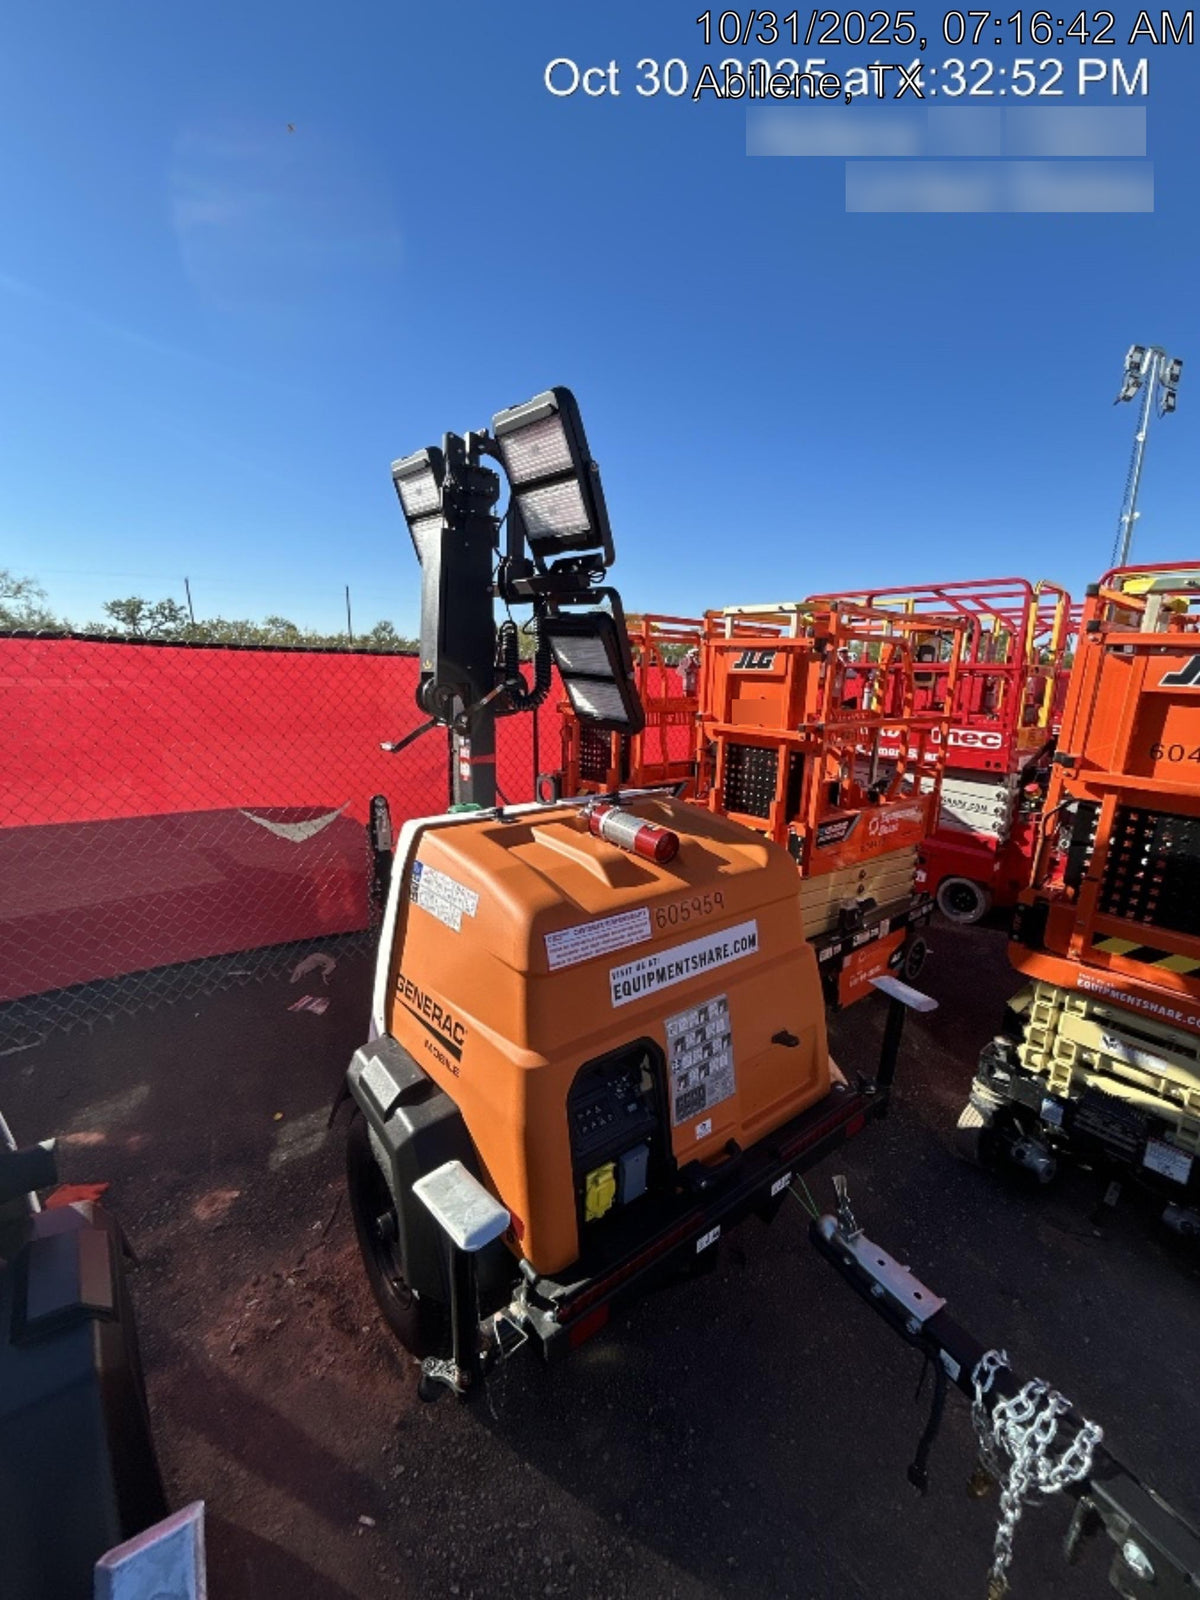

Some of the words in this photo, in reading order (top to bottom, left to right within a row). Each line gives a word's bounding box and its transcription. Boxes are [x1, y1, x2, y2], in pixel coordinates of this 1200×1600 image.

[732, 650, 777, 671] JLG
[655, 892, 725, 929] 605959
[613, 933, 757, 1000] EQUIPMENTSHARE.COM
[396, 973, 466, 1046] GENERAC
